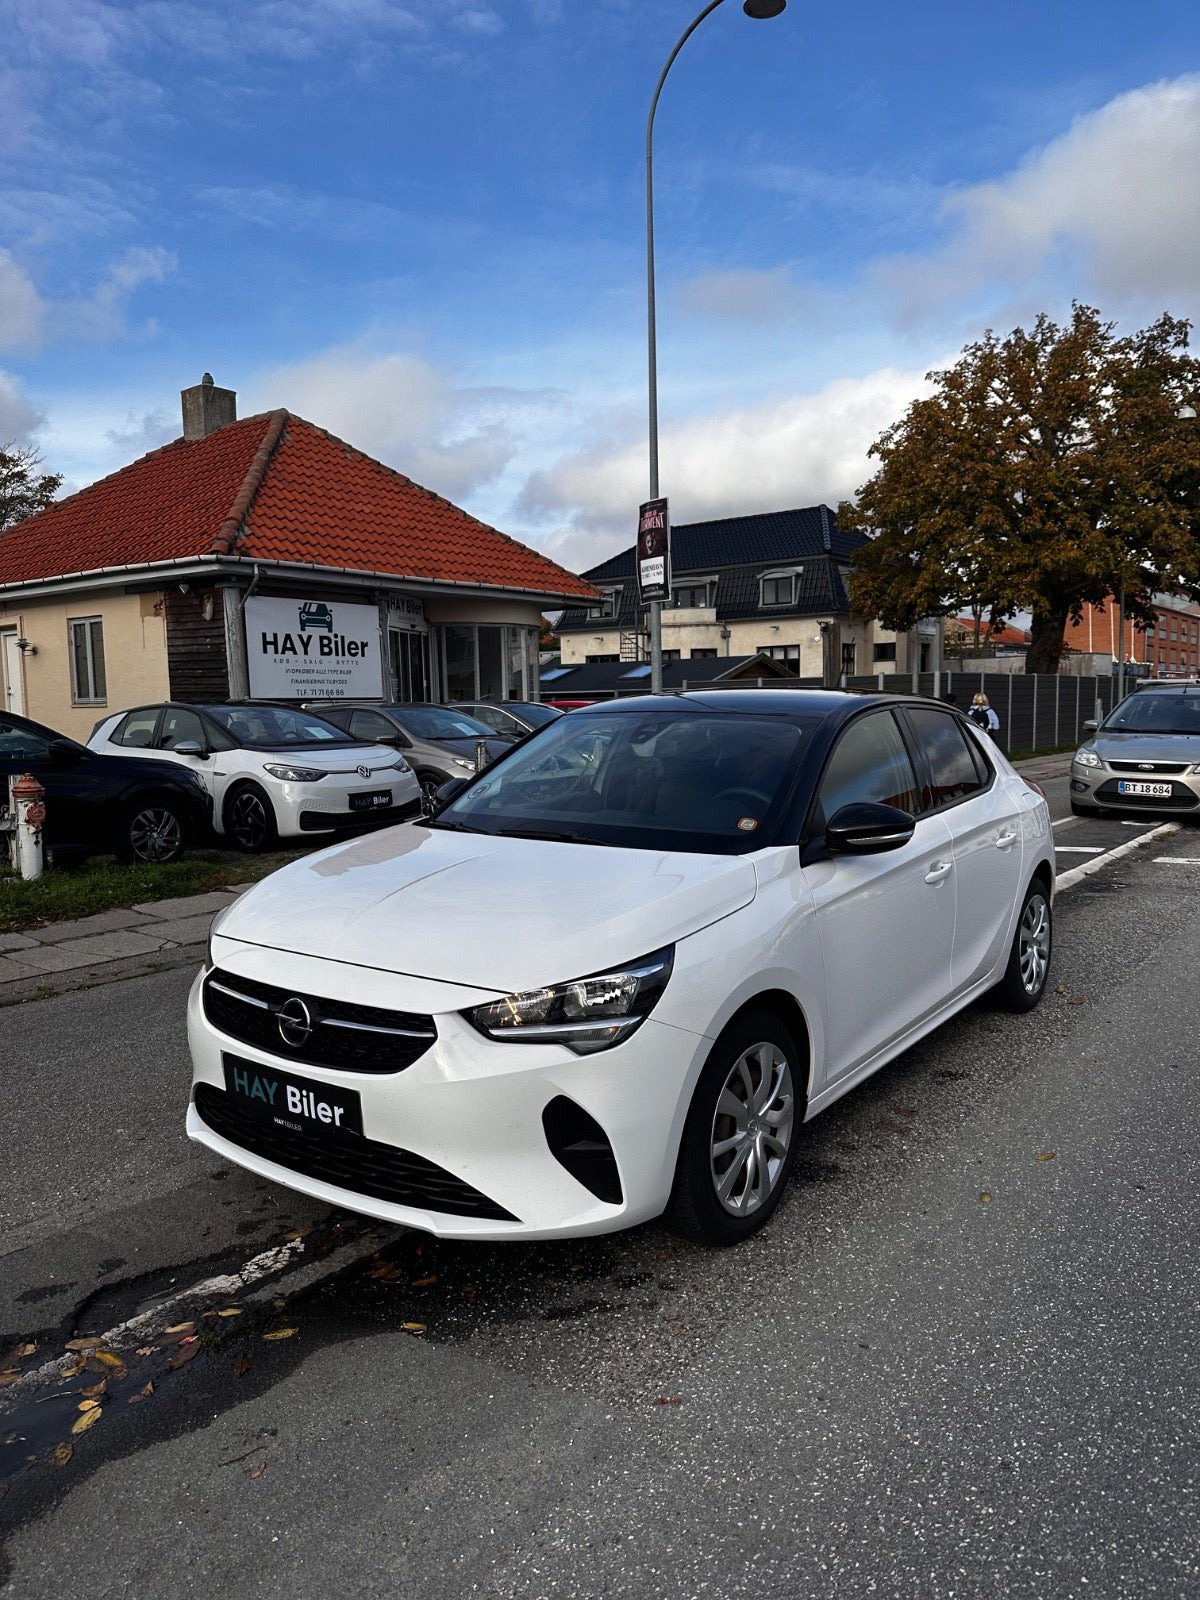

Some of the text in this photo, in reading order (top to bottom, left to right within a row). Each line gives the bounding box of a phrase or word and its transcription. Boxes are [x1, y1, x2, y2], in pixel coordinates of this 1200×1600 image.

[261, 631, 369, 658] HAY Biler
[1125, 783, 1170, 795] BT 18 684
[355, 795, 390, 808] HAY Biler
[233, 1067, 344, 1126] HAY Biler
